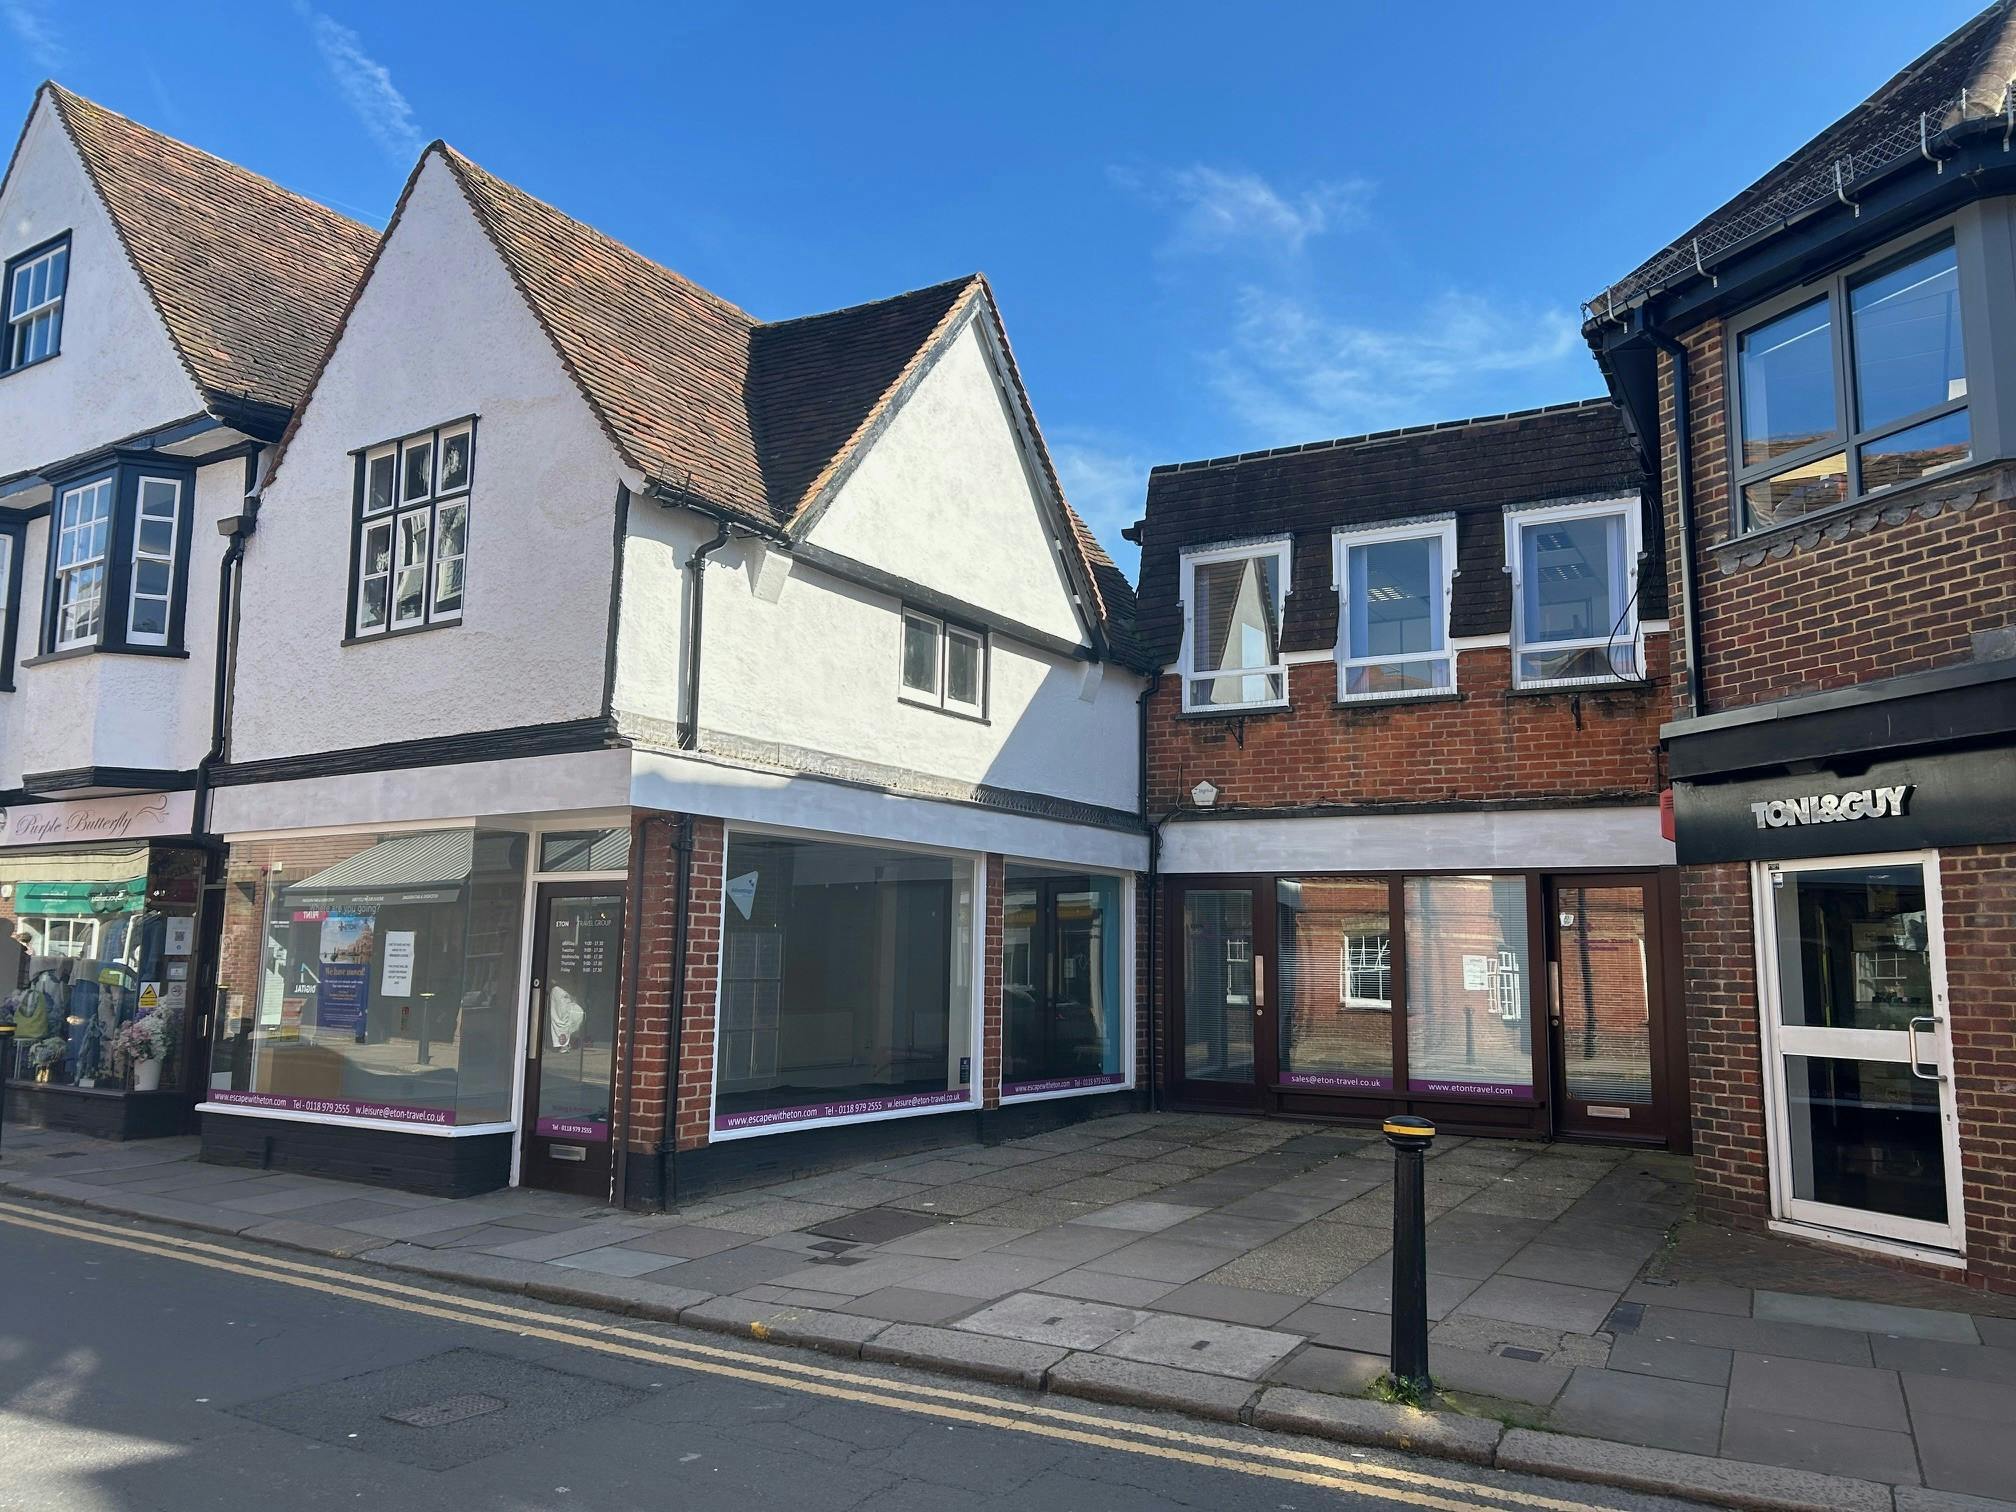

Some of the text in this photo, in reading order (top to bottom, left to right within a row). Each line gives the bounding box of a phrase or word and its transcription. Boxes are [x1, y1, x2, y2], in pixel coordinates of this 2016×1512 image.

[1751, 784, 1914, 829] TONI&GUY
[15, 809, 132, 841] Purple Butterfly
[344, 906, 356, 914] you
[358, 904, 380, 914] going?
[1291, 1075, 1381, 1087] sales@eton-travel.co.uk
[1428, 1083, 1513, 1095] www.etontravel.com
[214, 1092, 287, 1106] www.escapewitheton.com
[293, 1100, 302, 1109] Tel
[306, 1100, 320, 1111] 0118
[322, 1102, 334, 1112] 979
[334, 1104, 350, 1114] 2555
[355, 1104, 445, 1122] w.leisure@eton-travel.co.uk
[728, 1108, 818, 1126] www.escapewitheton.com
[824, 1106, 834, 1116] Tel
[838, 1104, 854, 1114] 0118
[855, 1102, 866, 1112] 979
[868, 1101, 882, 1111] 2555
[887, 1093, 960, 1108] w.leisure@eton-travel.co.uk
